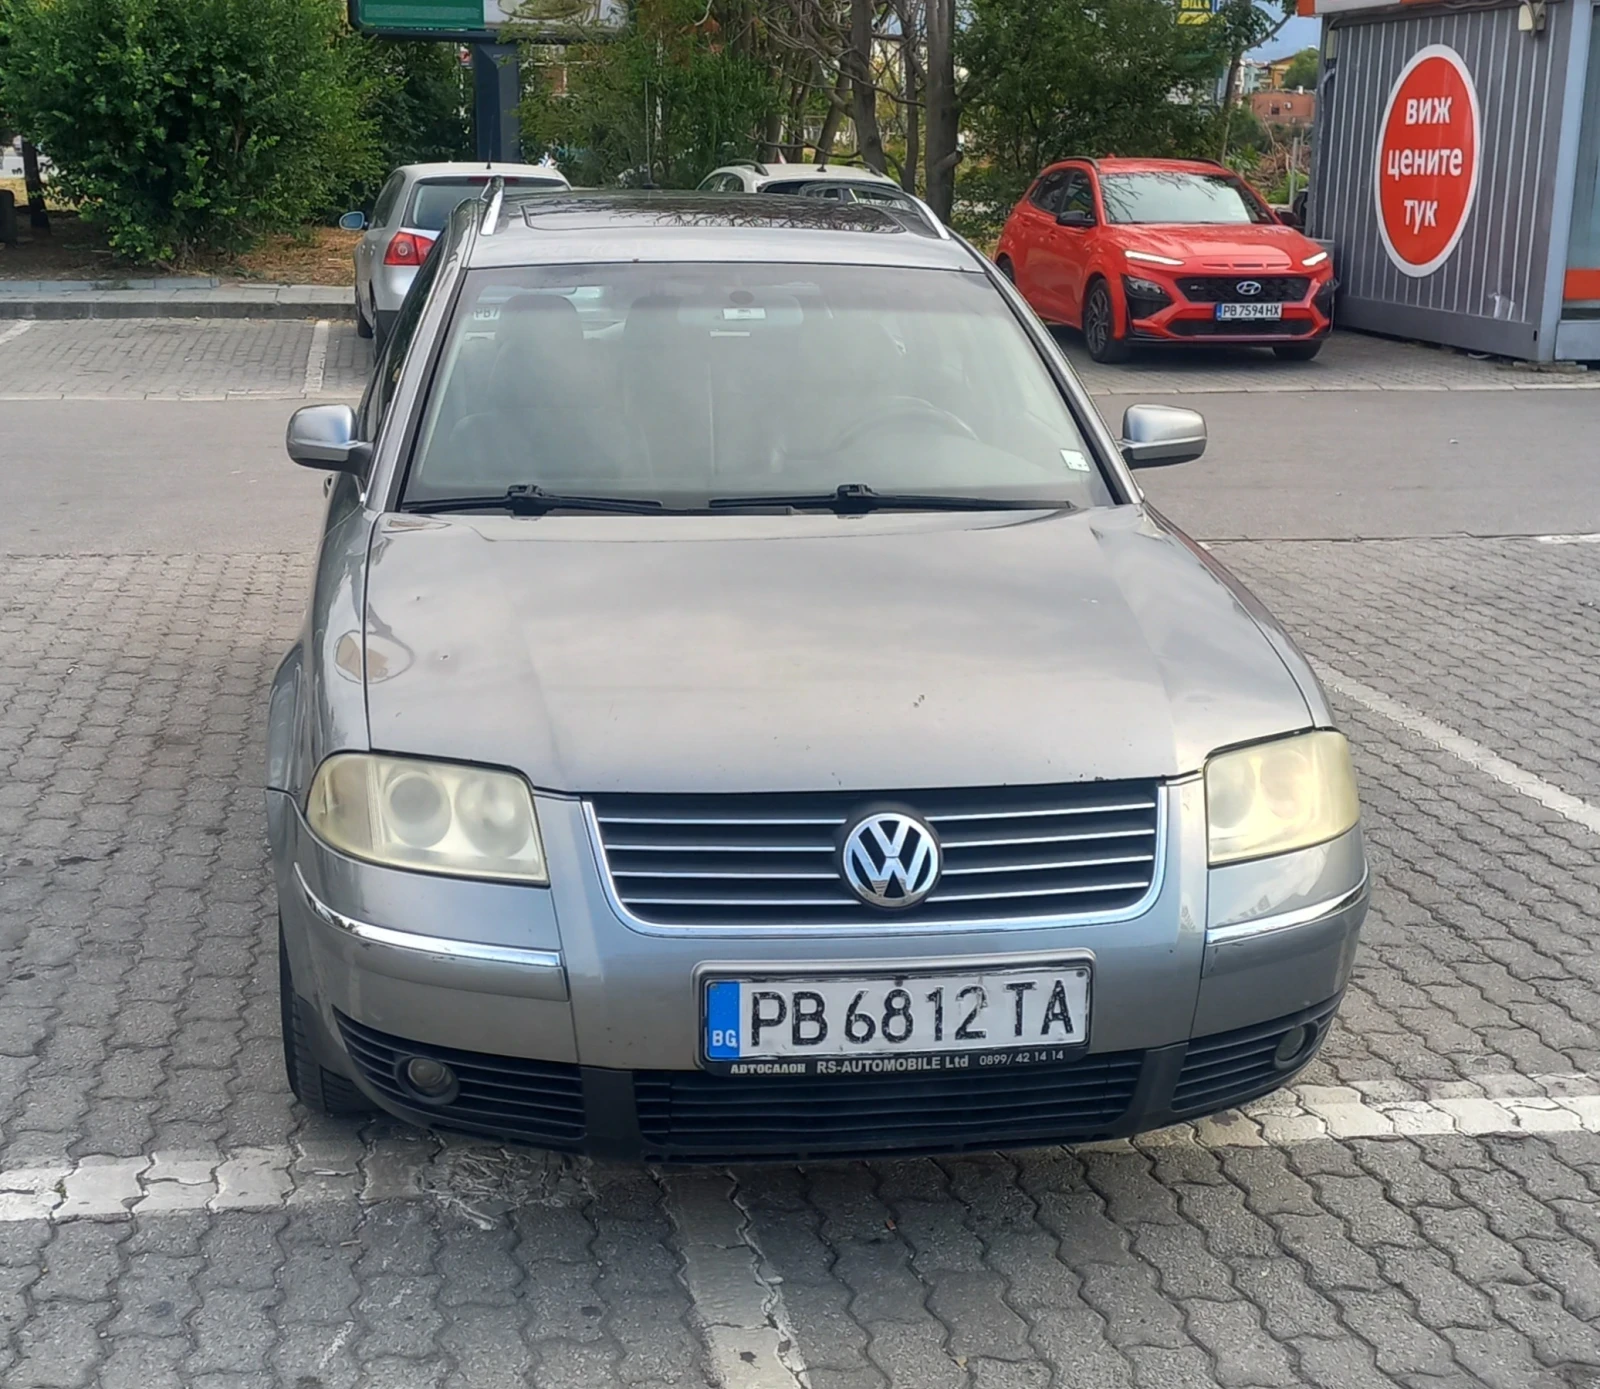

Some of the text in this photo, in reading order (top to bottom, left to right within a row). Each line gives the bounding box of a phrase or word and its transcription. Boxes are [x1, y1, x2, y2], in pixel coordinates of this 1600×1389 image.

[1405, 96, 1452, 125] виж
[1387, 148, 1463, 181] цените
[1403, 199, 1438, 235] тук
[1223, 305, 1237, 316] PB
[1239, 304, 1264, 316] 7594
[1265, 304, 1280, 316] HX
[750, 979, 1074, 1047] PB 6812 TA
[712, 1030, 737, 1048] BG
[816, 1055, 969, 1074] RS-AUTOMOBILE Ltd
[1015, 1052, 1030, 1063] 42
[1034, 1051, 1047, 1061] 14
[1051, 1050, 1064, 1060] 14
[730, 1063, 806, 1074] АВТОСАЛОН
